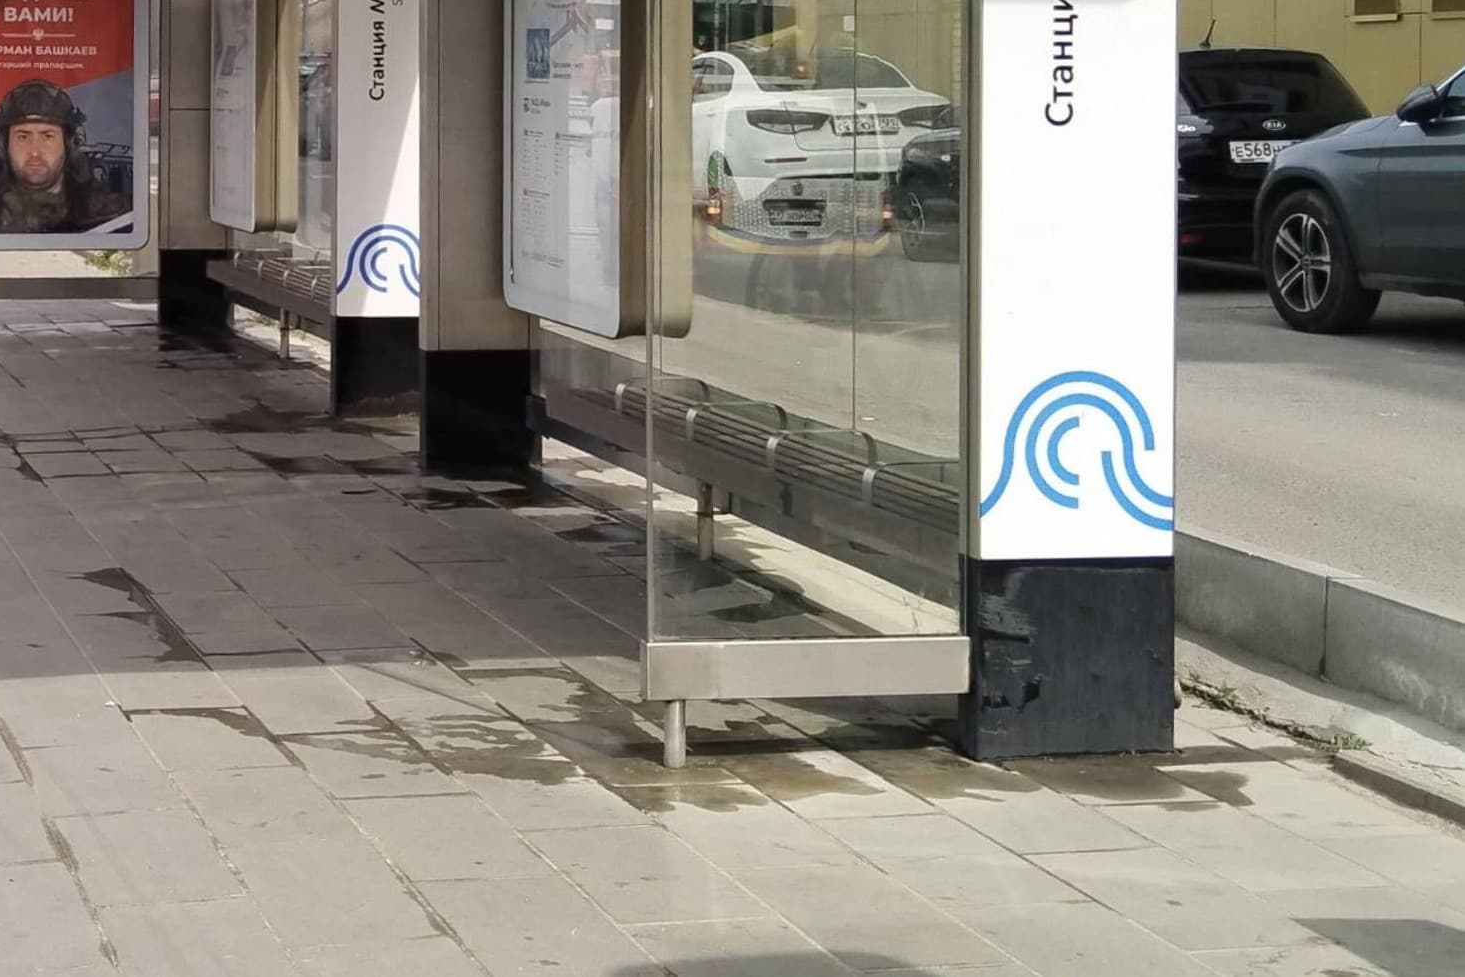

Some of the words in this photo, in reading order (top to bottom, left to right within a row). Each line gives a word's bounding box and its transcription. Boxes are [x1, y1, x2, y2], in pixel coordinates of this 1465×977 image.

[3, 6, 75, 23] ВАМИ!
[35, 44, 98, 56] БАШКАЕВ
[368, 20, 388, 101] Станция
